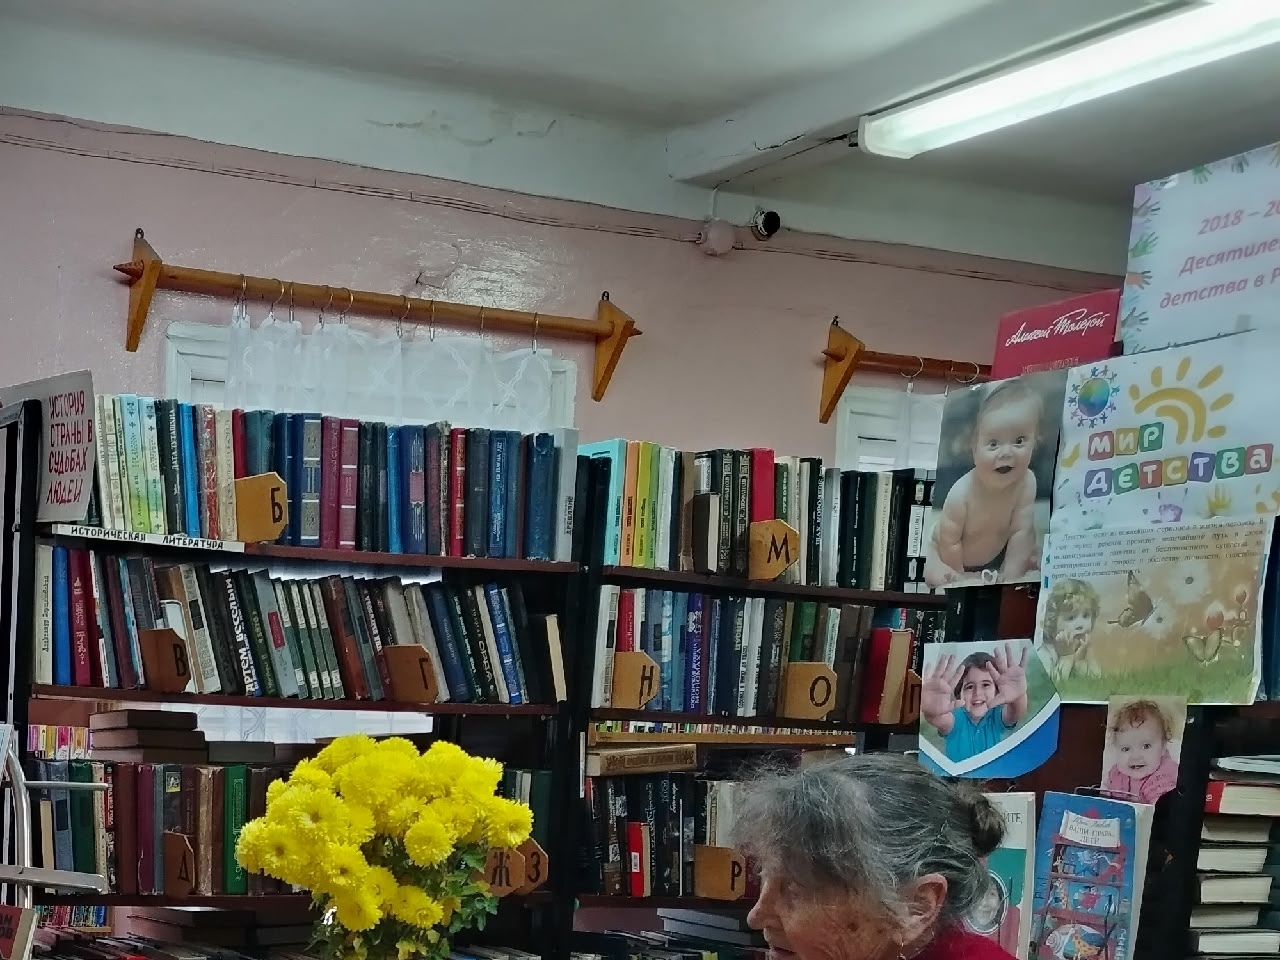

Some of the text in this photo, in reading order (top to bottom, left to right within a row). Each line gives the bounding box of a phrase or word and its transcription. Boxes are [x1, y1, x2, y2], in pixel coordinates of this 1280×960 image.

[1198, 209, 1244, 235] 2018
[1179, 238, 1280, 277] Десятиле
[1160, 278, 1248, 309] детства
[1253, 274, 1265, 288] в
[48, 390, 85, 420] ИСТОРИЯ
[50, 419, 94, 447] СТРАНЫ В
[1089, 425, 1160, 457] МИР
[48, 446, 89, 476] СУДЬБАХ
[45, 474, 84, 505] ЛЮДЕЙ
[270, 487, 284, 525] Б
[71, 526, 224, 551] ИСТОРИЧЕСКАЯ ЛИТЕРАТУРА
[767, 532, 791, 565] М
[809, 674, 832, 707] О
[731, 860, 743, 887] Р
